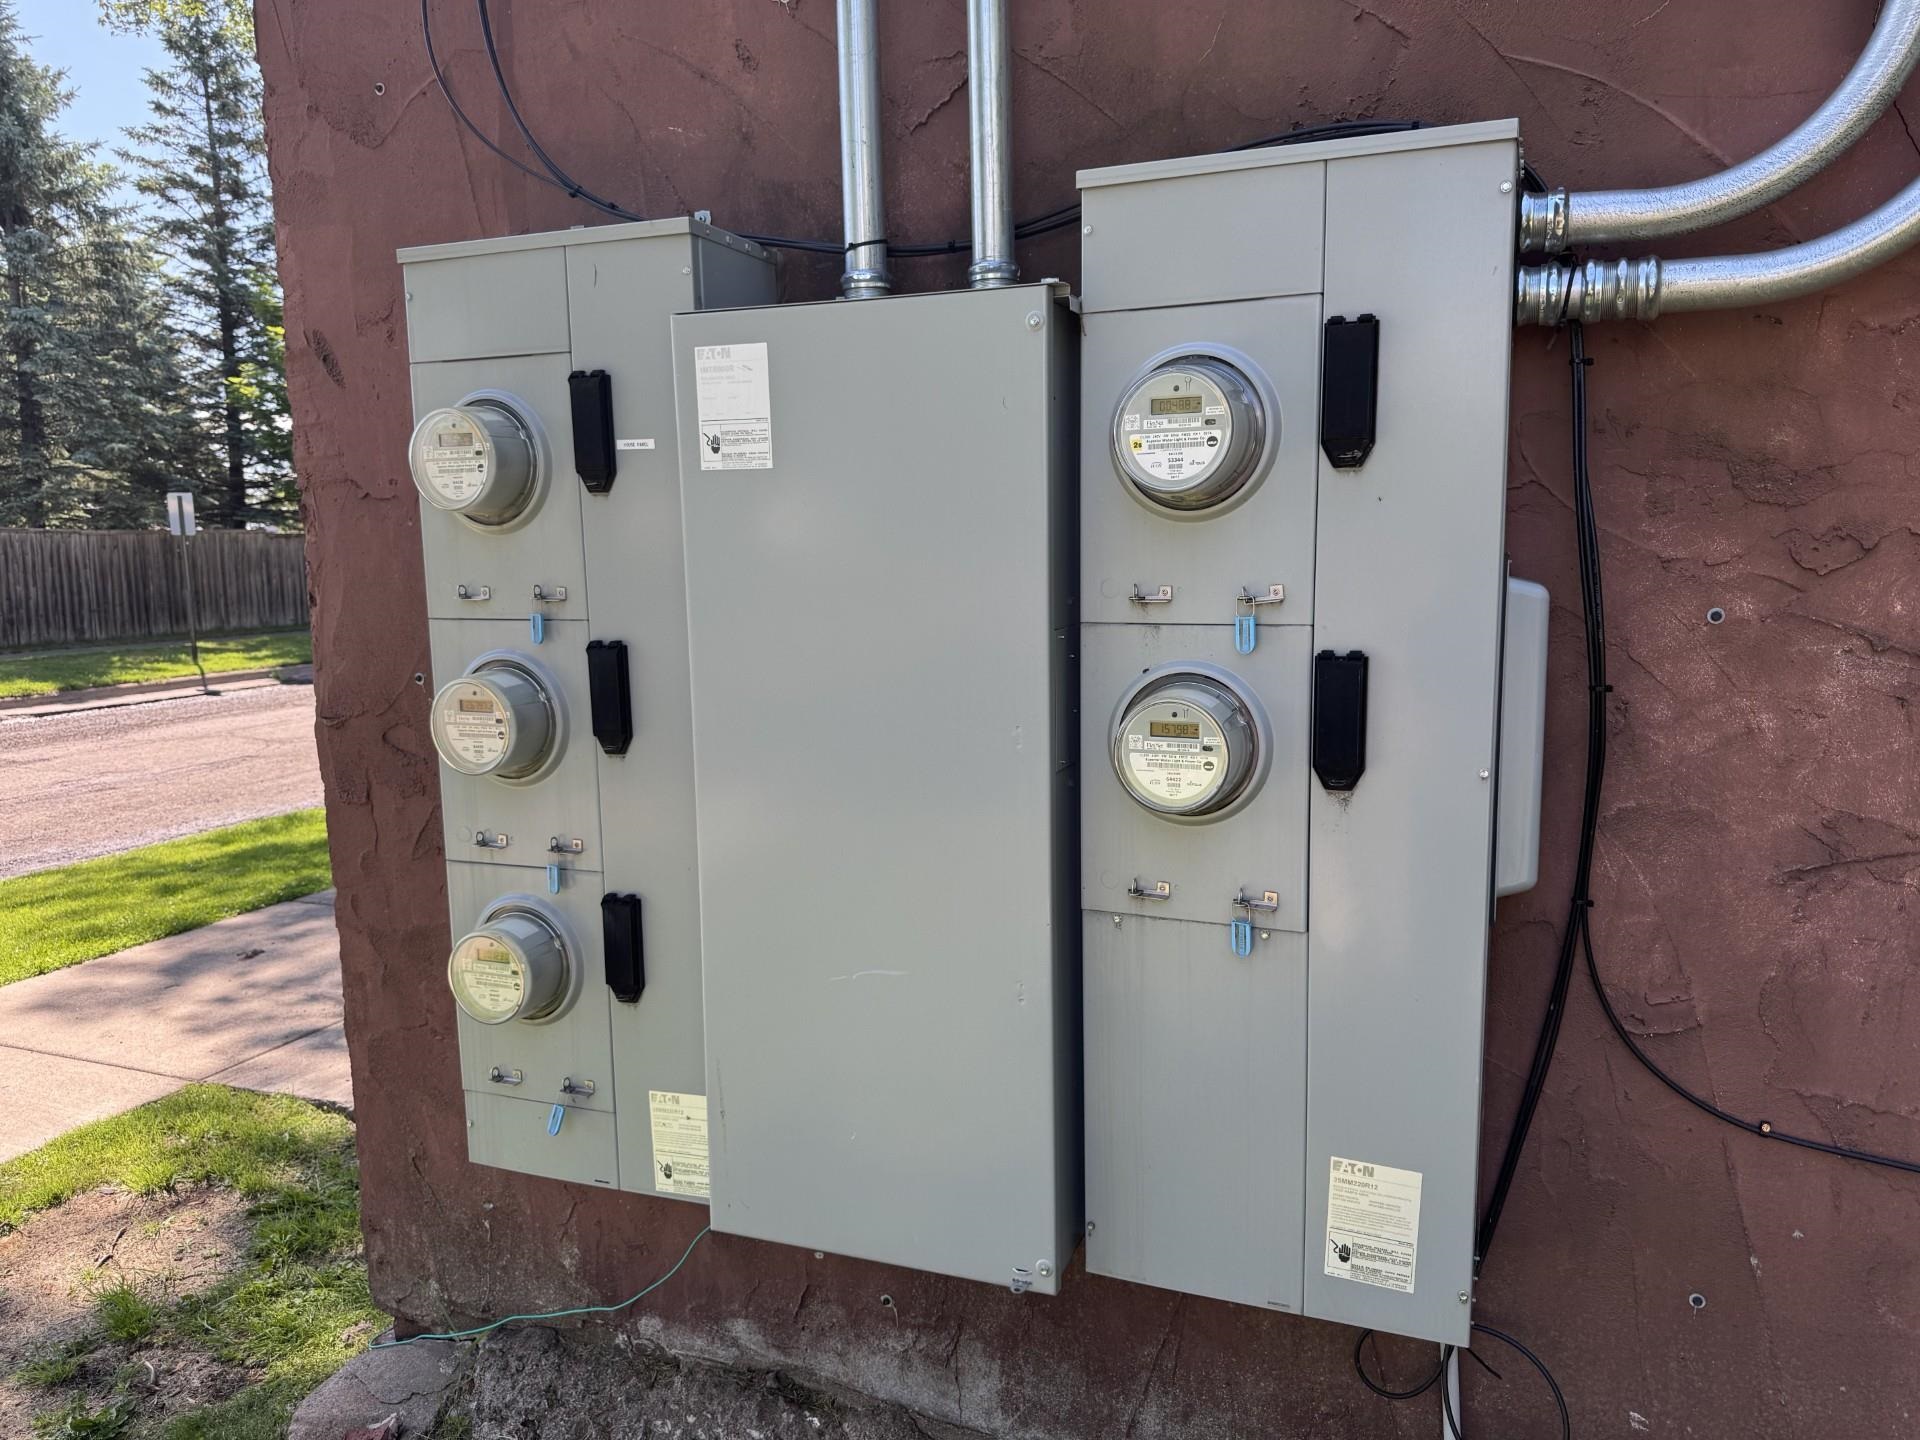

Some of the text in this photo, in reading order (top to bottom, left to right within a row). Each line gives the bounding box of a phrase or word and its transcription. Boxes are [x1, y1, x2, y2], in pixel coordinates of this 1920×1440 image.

[697, 347, 731, 360] EATON
[651, 1093, 680, 1105] EATON
[1332, 1160, 1375, 1178] EATON
